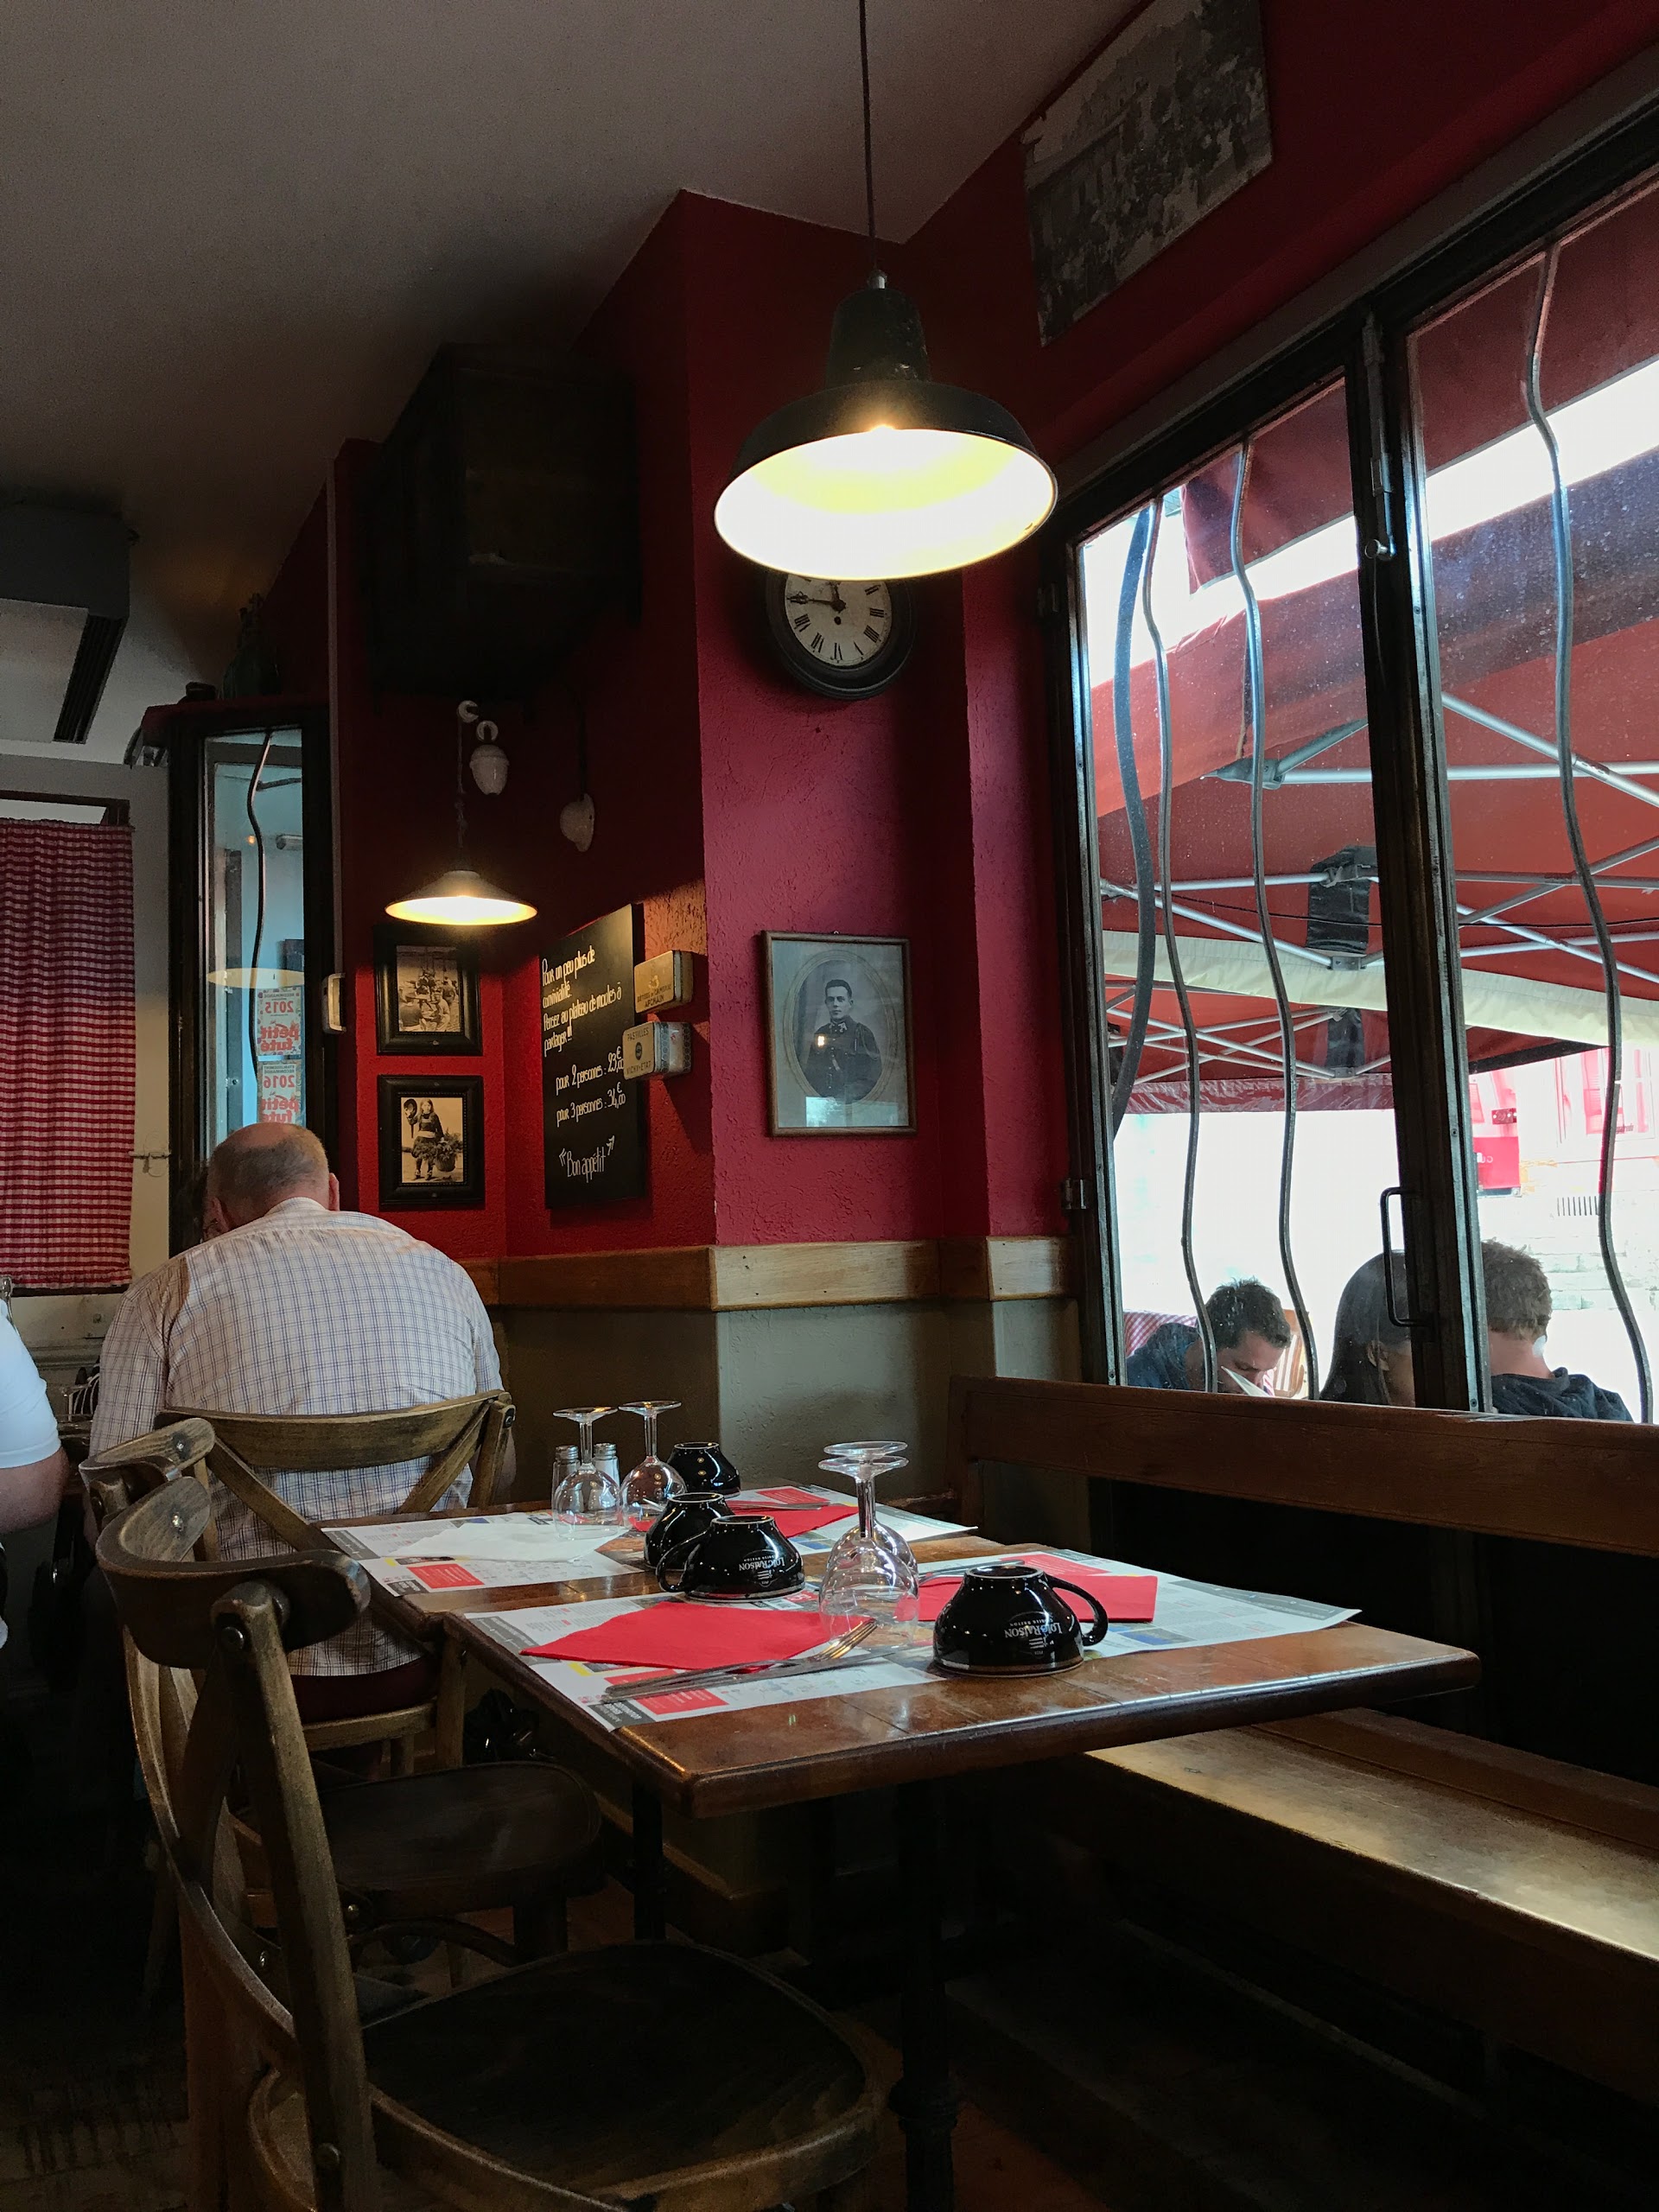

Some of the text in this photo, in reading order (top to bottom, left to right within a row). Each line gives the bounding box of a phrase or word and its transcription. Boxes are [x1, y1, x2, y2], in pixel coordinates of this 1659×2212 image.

[542, 944, 595, 987] Pour un peu plus de
[543, 982, 622, 1032] Pensez au plateau de moules à
[626, 1027, 650, 1041] PASTILLES
[556, 1075, 570, 1096] pour
[571, 1064, 577, 1086] 2
[556, 1109, 570, 1128] pour
[570, 1102, 576, 1118] 3
